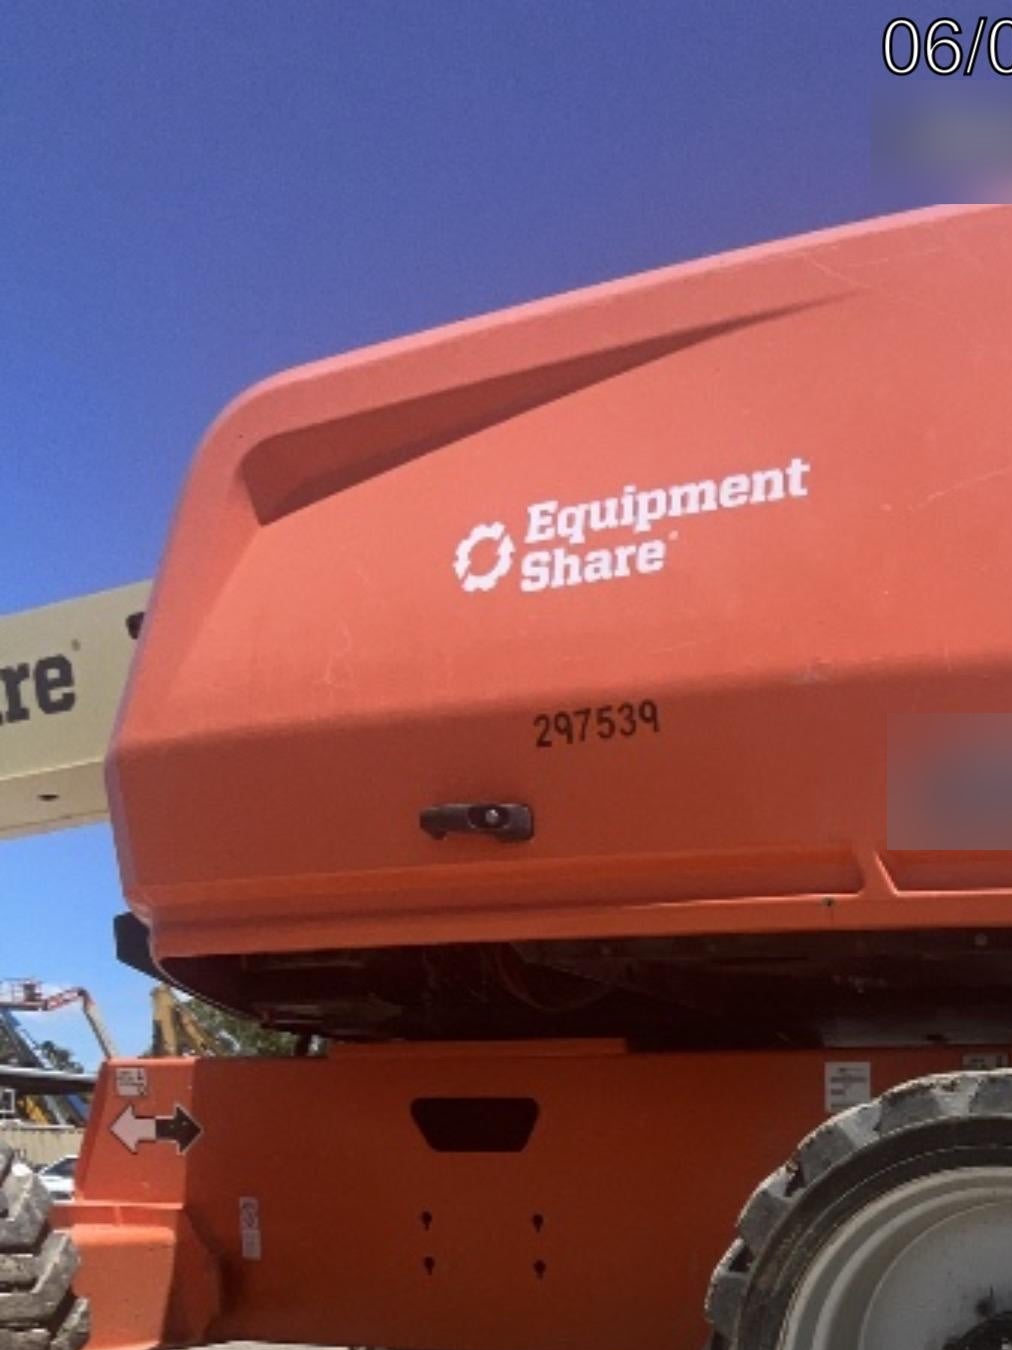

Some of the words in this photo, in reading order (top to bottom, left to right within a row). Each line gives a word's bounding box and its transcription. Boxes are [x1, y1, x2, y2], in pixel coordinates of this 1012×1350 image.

[524, 457, 810, 545] Equipment
[520, 538, 667, 592] Share
[0, 654, 76, 726] re
[533, 699, 660, 748] 297539
